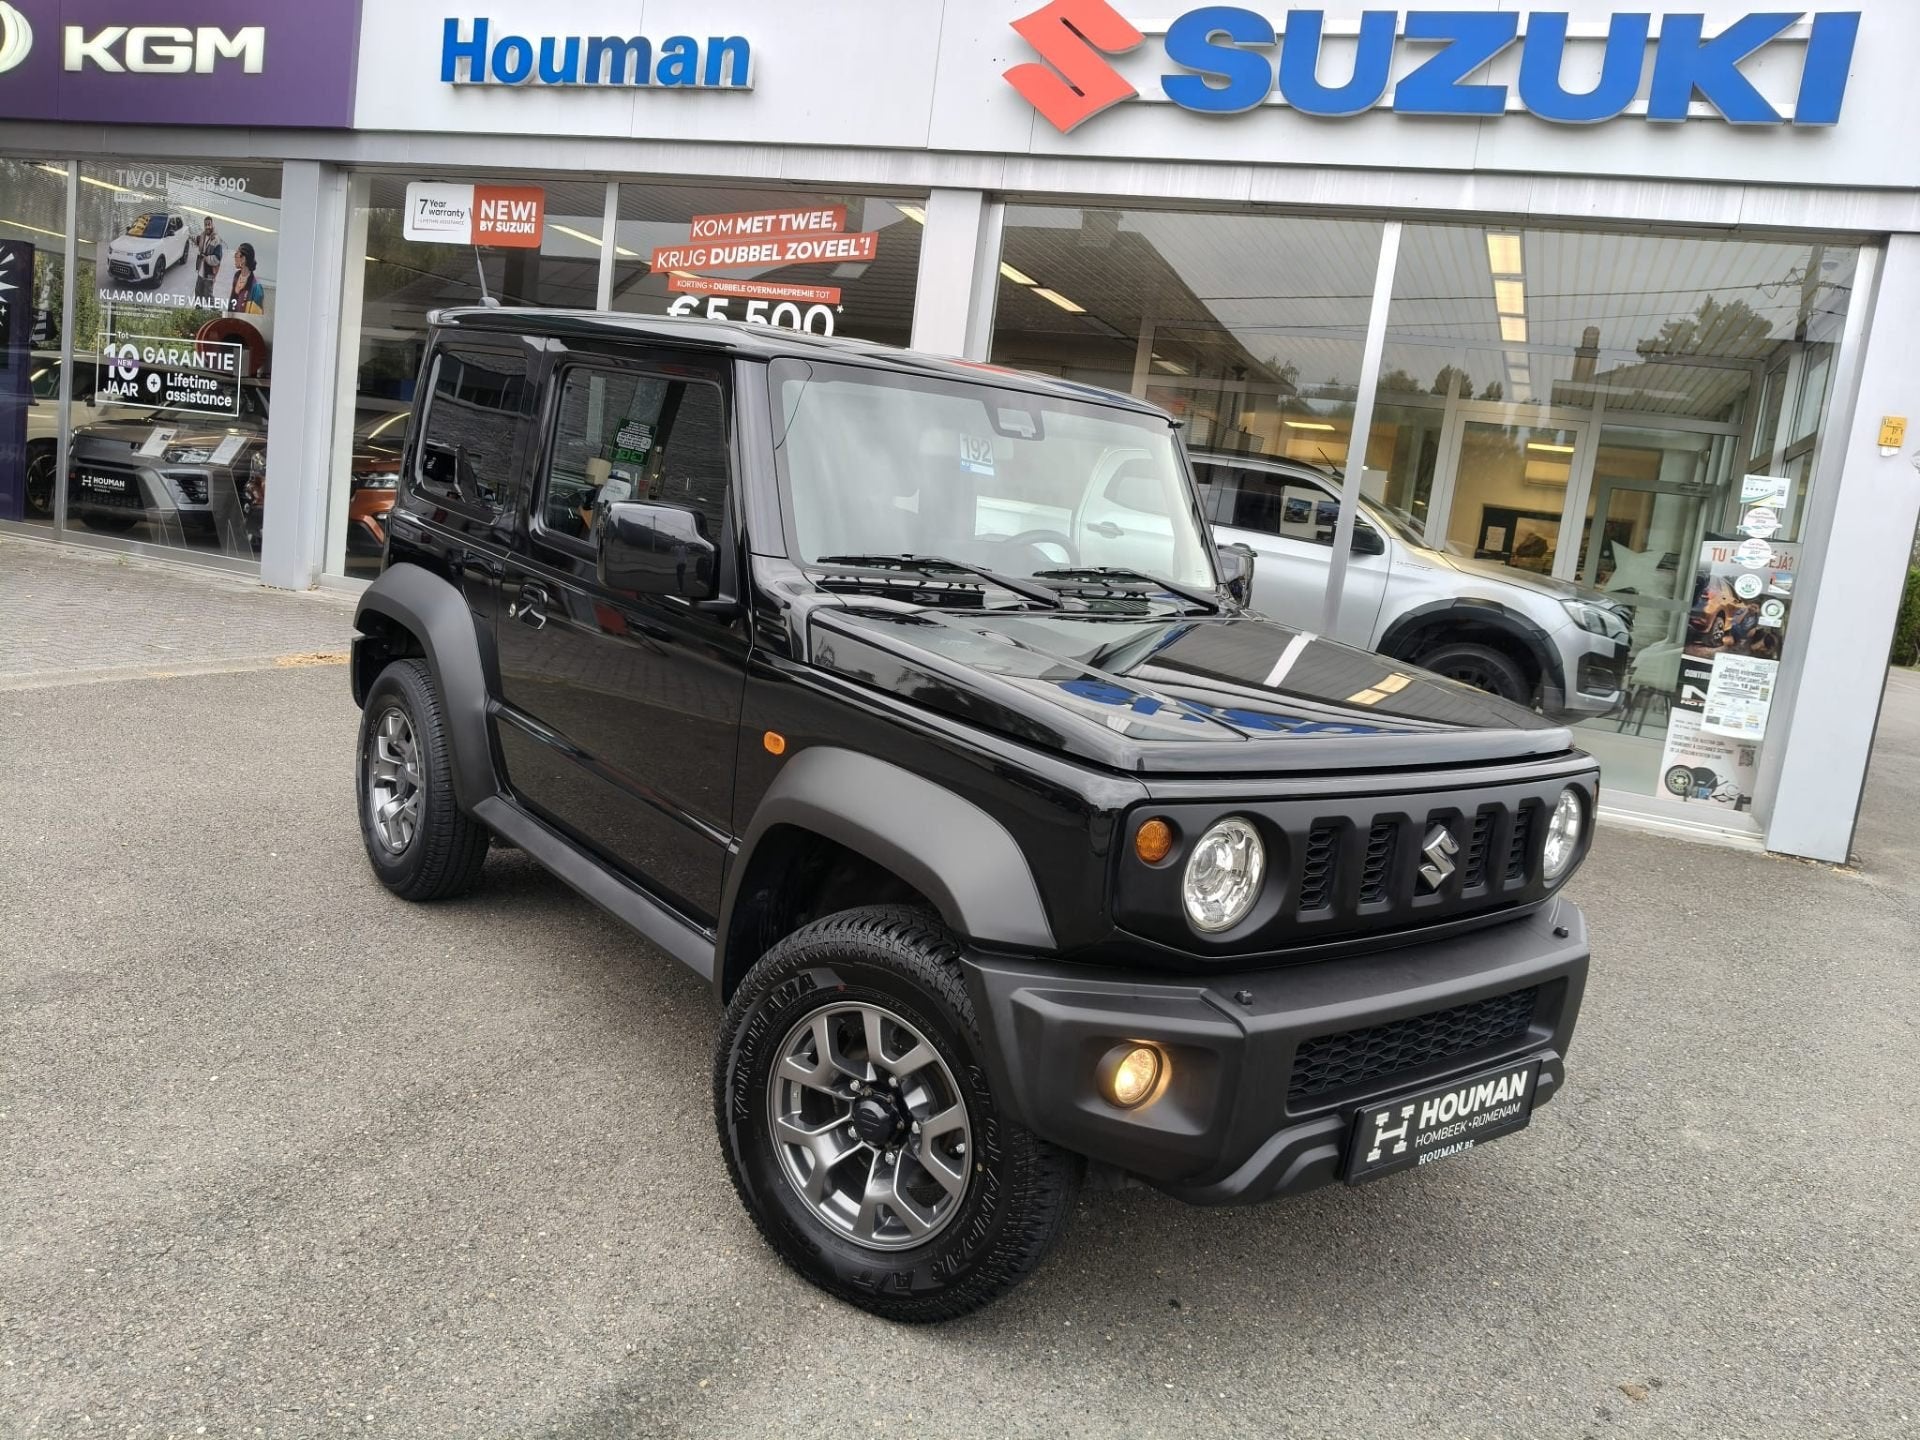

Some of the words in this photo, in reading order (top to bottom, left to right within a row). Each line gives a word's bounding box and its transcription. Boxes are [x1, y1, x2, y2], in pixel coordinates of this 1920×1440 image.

[65, 26, 265, 73] KGM
[441, 17, 751, 87] Houman
[1160, 5, 1862, 127] SUZUKI
[116, 169, 170, 189] TIVOLI
[419, 198, 429, 215] 7
[429, 199, 447, 208] Year
[428, 208, 465, 219] warranty
[480, 199, 537, 222] NEW!
[480, 220, 494, 231] BY
[496, 221, 535, 234] SUZUKI
[692, 219, 733, 237] KOM
[735, 215, 777, 234] MET
[779, 210, 838, 231] TWEE,
[657, 250, 707, 268] KRIJG
[709, 245, 782, 265] DUBBEL
[99, 289, 134, 301] KLAAR
[136, 291, 153, 304] OM
[155, 293, 170, 305] OP
[172, 294, 185, 306] TE
[187, 295, 229, 309] VALLEN
[677, 279, 708, 289] KORTING
[713, 283, 746, 293] DUBBELE
[746, 285, 815, 298] OVERNAMEPREMIE
[815, 290, 830, 299] TOT
[117, 331, 129, 340] Tot
[103, 343, 139, 381] 10
[117, 359, 133, 367] NEW
[143, 346, 235, 371] GARANTIE
[103, 381, 139, 398] JAAR
[166, 373, 218, 391] Lifetime
[166, 390, 232, 407] assistance
[93, 476, 125, 487] HOUMAN
[1711, 547, 1727, 562] TU
[1764, 550, 1794, 571] ÉJÀ?
[1419, 1070, 1528, 1129] HOUMAN
[1415, 1120, 1468, 1148] HOMBEEK
